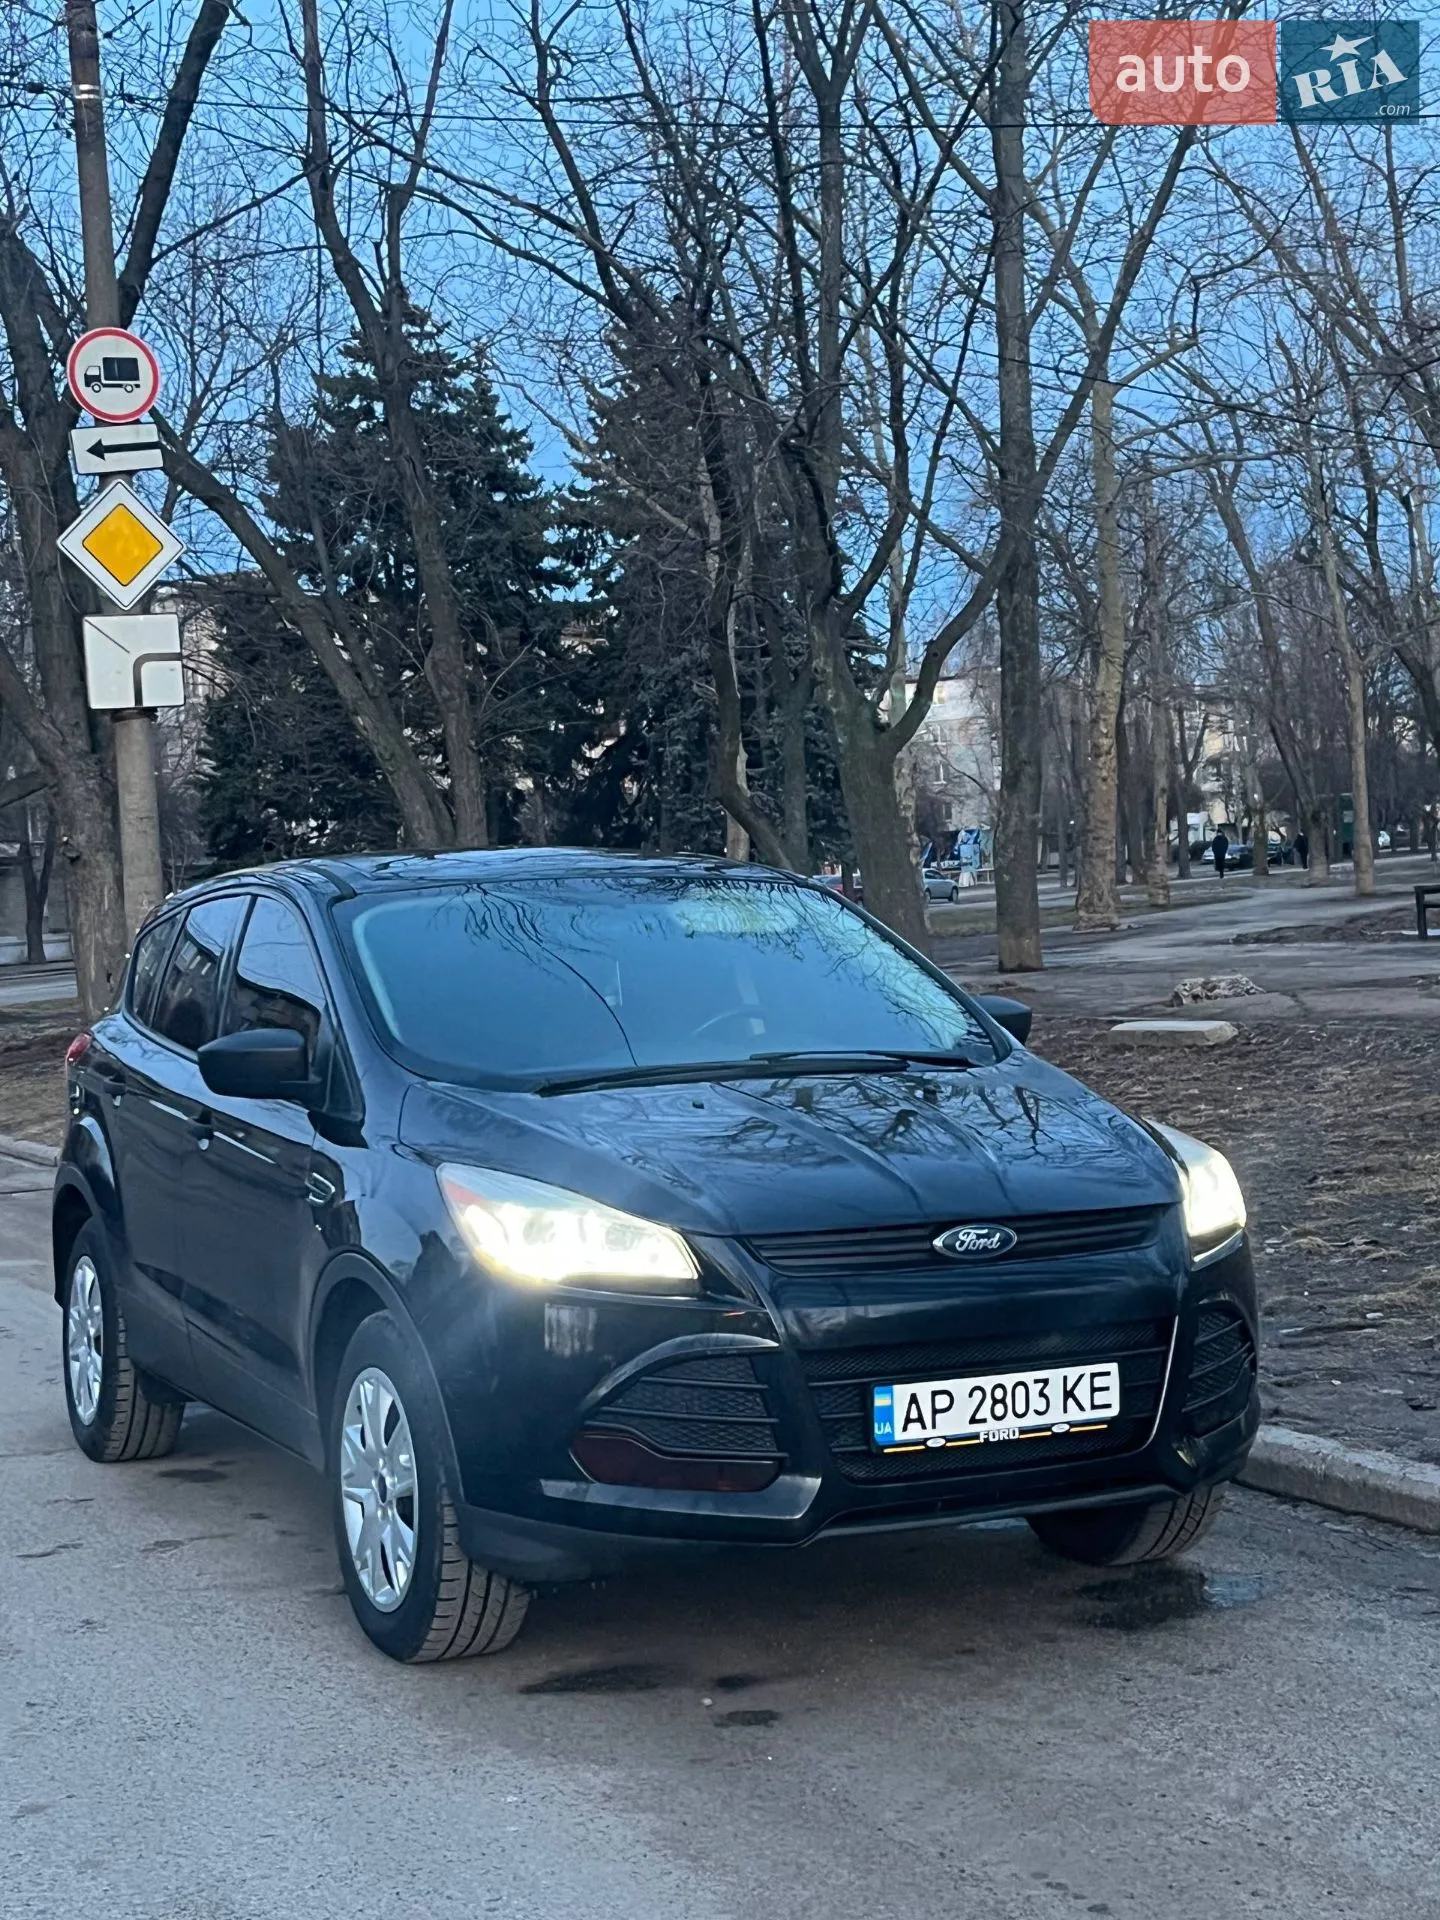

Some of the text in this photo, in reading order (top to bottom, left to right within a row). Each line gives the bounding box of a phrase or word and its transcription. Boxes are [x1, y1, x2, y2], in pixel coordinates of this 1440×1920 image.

[955, 1228, 1001, 1251] Ford
[901, 1371, 1112, 1432] AP 2803 KE
[874, 1422, 893, 1434] UA
[979, 1427, 1020, 1443] FORD
